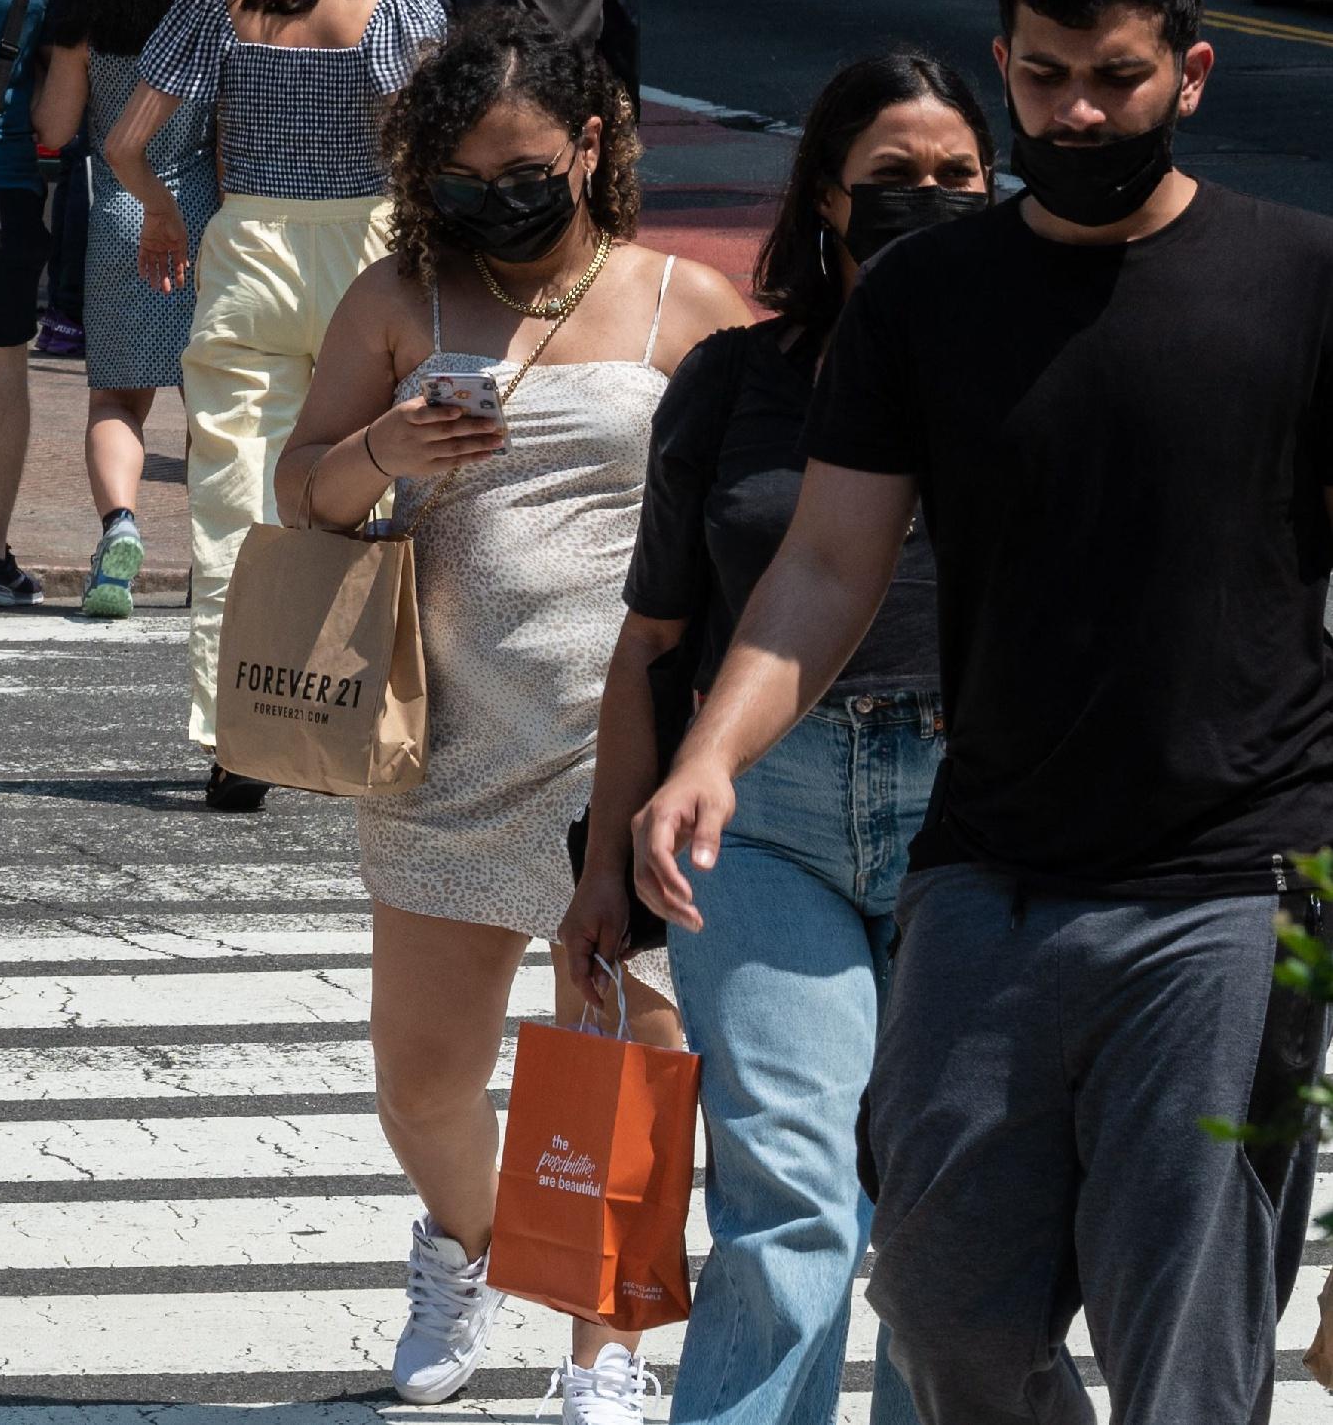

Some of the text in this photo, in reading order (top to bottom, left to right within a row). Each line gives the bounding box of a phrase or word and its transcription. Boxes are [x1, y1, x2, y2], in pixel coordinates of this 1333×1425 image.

[236, 661, 363, 709] FOREVER 21
[254, 702, 330, 726] FOREVER21.COM
[552, 1134, 569, 1151] the
[535, 1150, 596, 1179] possibilities
[539, 1175, 602, 1198] are beautiful
